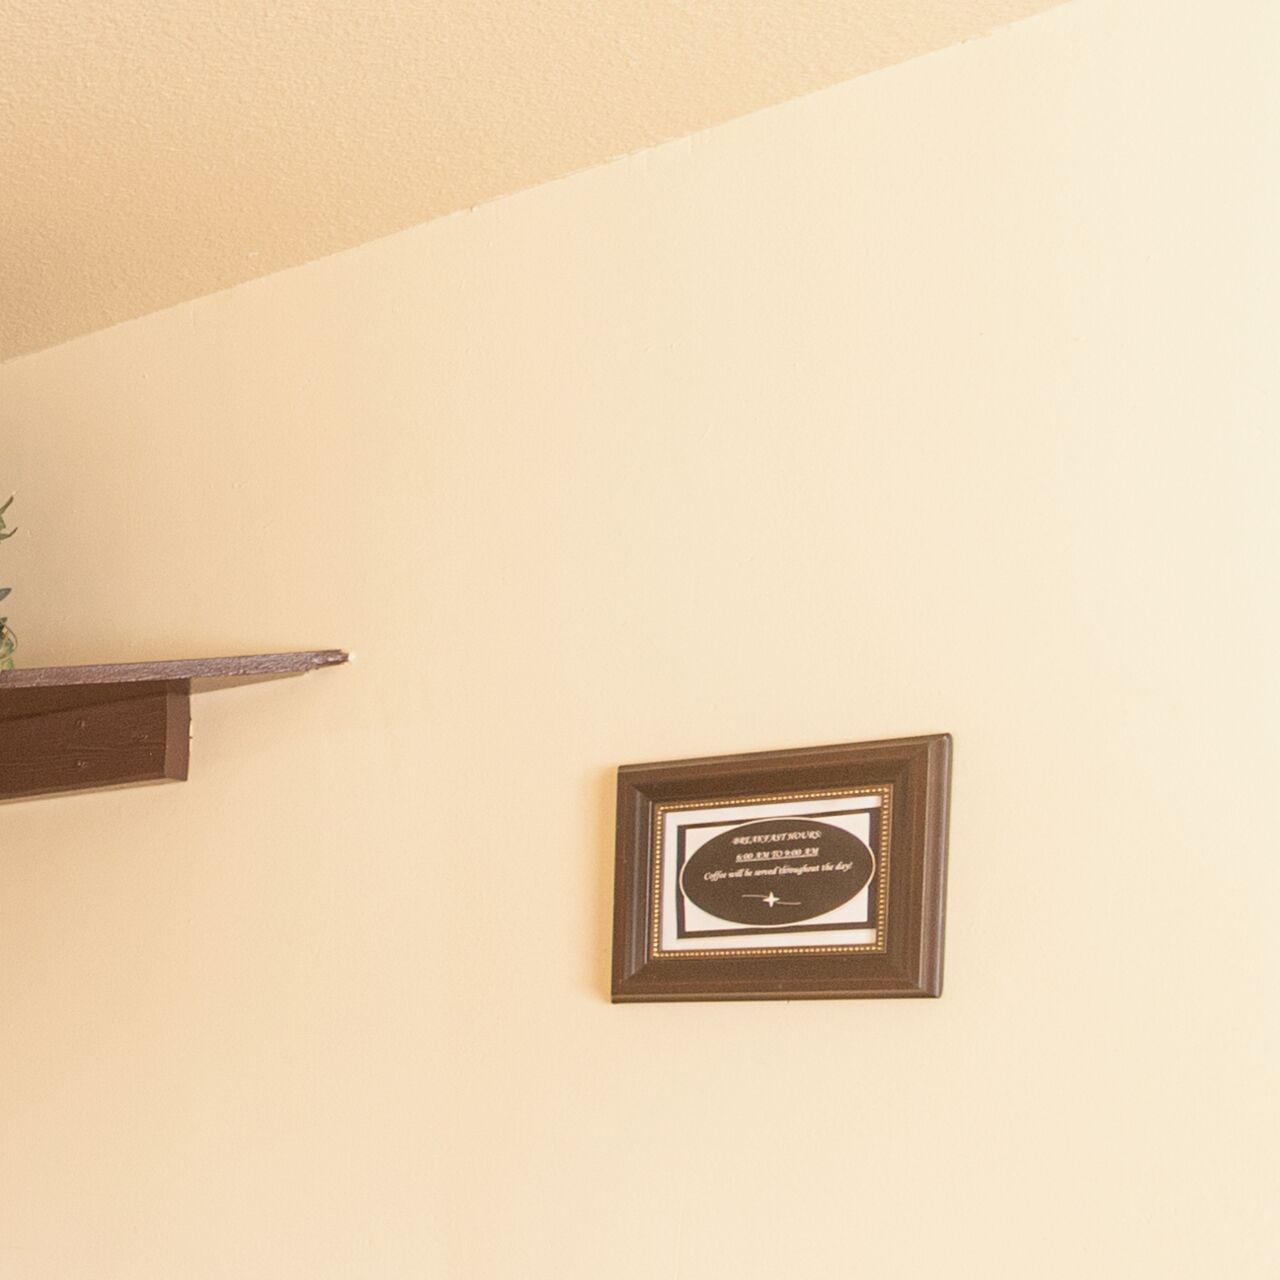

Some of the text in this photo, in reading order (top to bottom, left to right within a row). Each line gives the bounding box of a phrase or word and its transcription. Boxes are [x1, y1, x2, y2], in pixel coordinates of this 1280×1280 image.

[704, 870, 727, 882] Coffee
[728, 868, 744, 878] will
[744, 868, 753, 877] be
[754, 866, 778, 877] served
[778, 864, 820, 876] throughout
[821, 862, 834, 872] the
